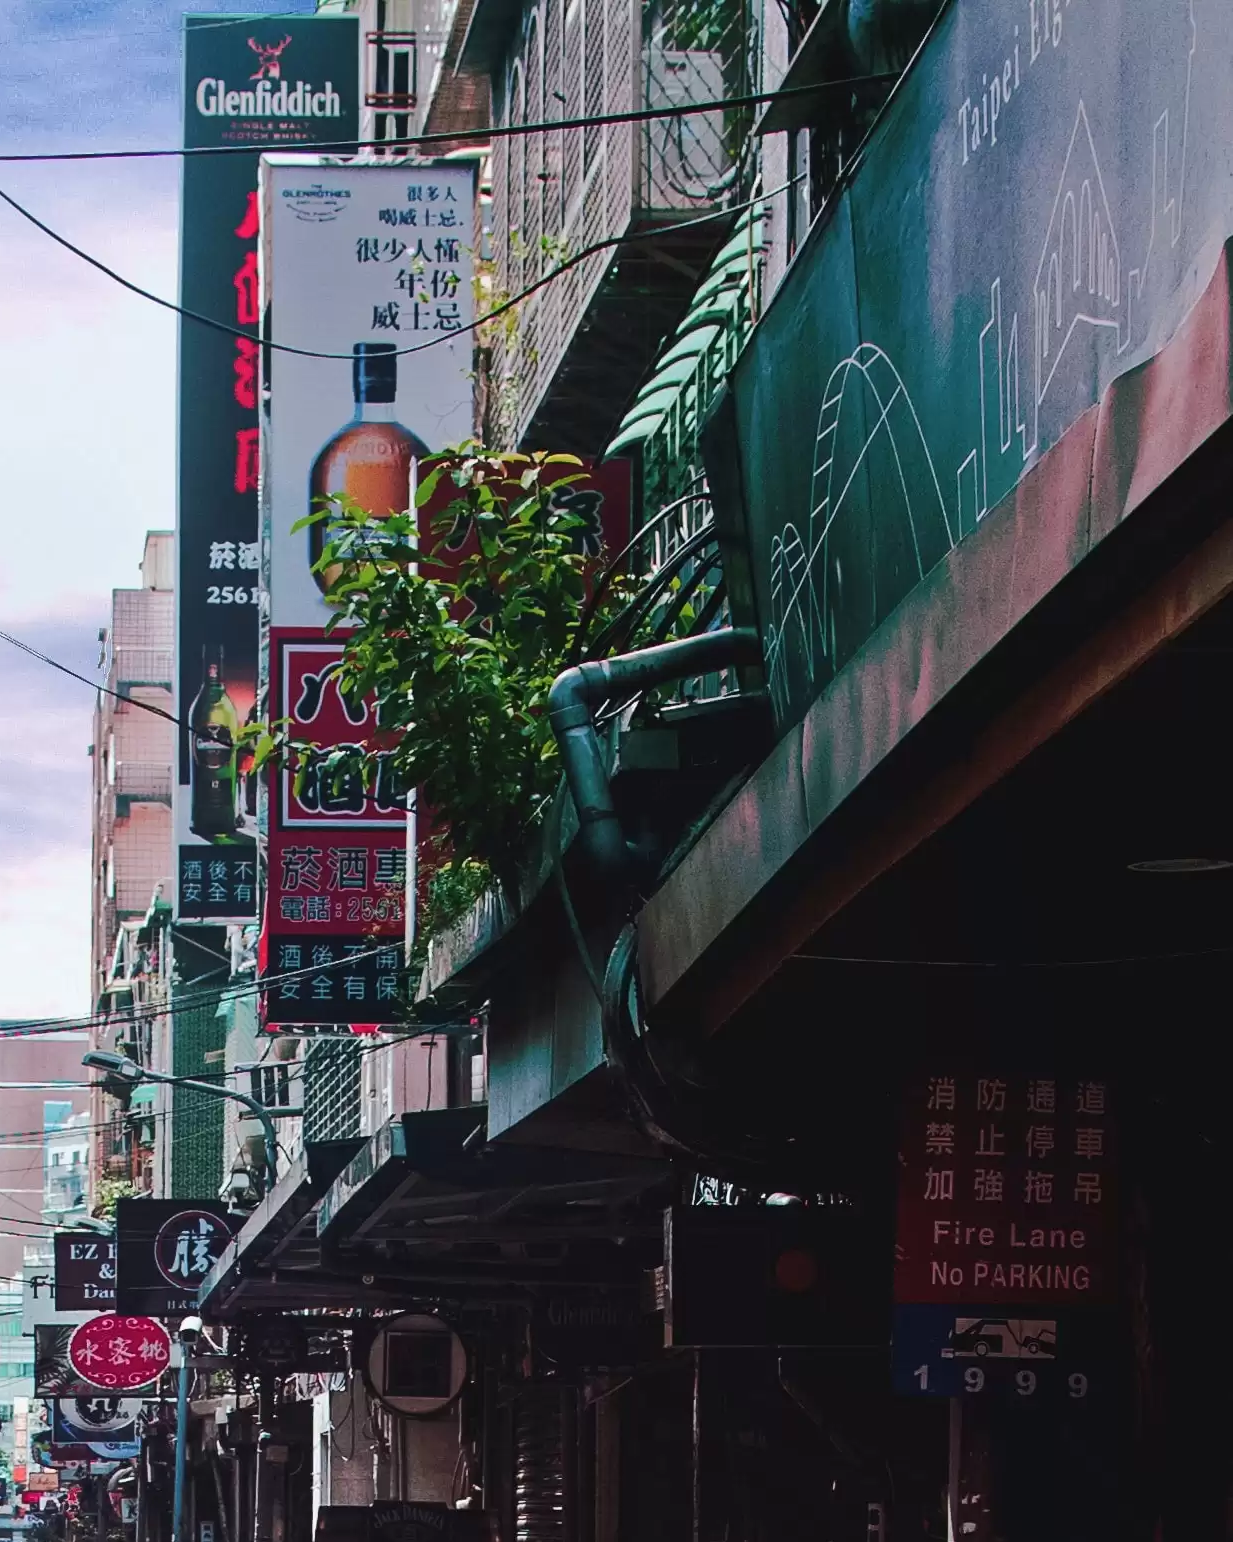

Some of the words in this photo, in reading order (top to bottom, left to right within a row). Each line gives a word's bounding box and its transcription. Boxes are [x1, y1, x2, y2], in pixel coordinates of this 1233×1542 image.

[196, 78, 340, 117] Glenfiddich
[958, 25, 1020, 167] Taipei
[1029, 0, 1070, 66] Eig
[407, 186, 457, 202] 很多人
[356, 237, 460, 264] 很少人懂
[394, 268, 461, 299] 年份
[371, 301, 462, 331] 威士忌
[182, 860, 254, 881] 酒後不
[182, 883, 253, 903] 安全有
[927, 1076, 1107, 1116] 消防通道
[925, 1122, 1105, 1160] 禁止停車
[923, 1168, 1103, 1205] 加強拖吊
[933, 1220, 995, 1246] Fire
[1009, 1222, 1087, 1249] Lane
[70, 1244, 99, 1260] EZ
[930, 1261, 964, 1287] No
[973, 1262, 1091, 1291] PARKING
[913, 1363, 1089, 1399] 1999
